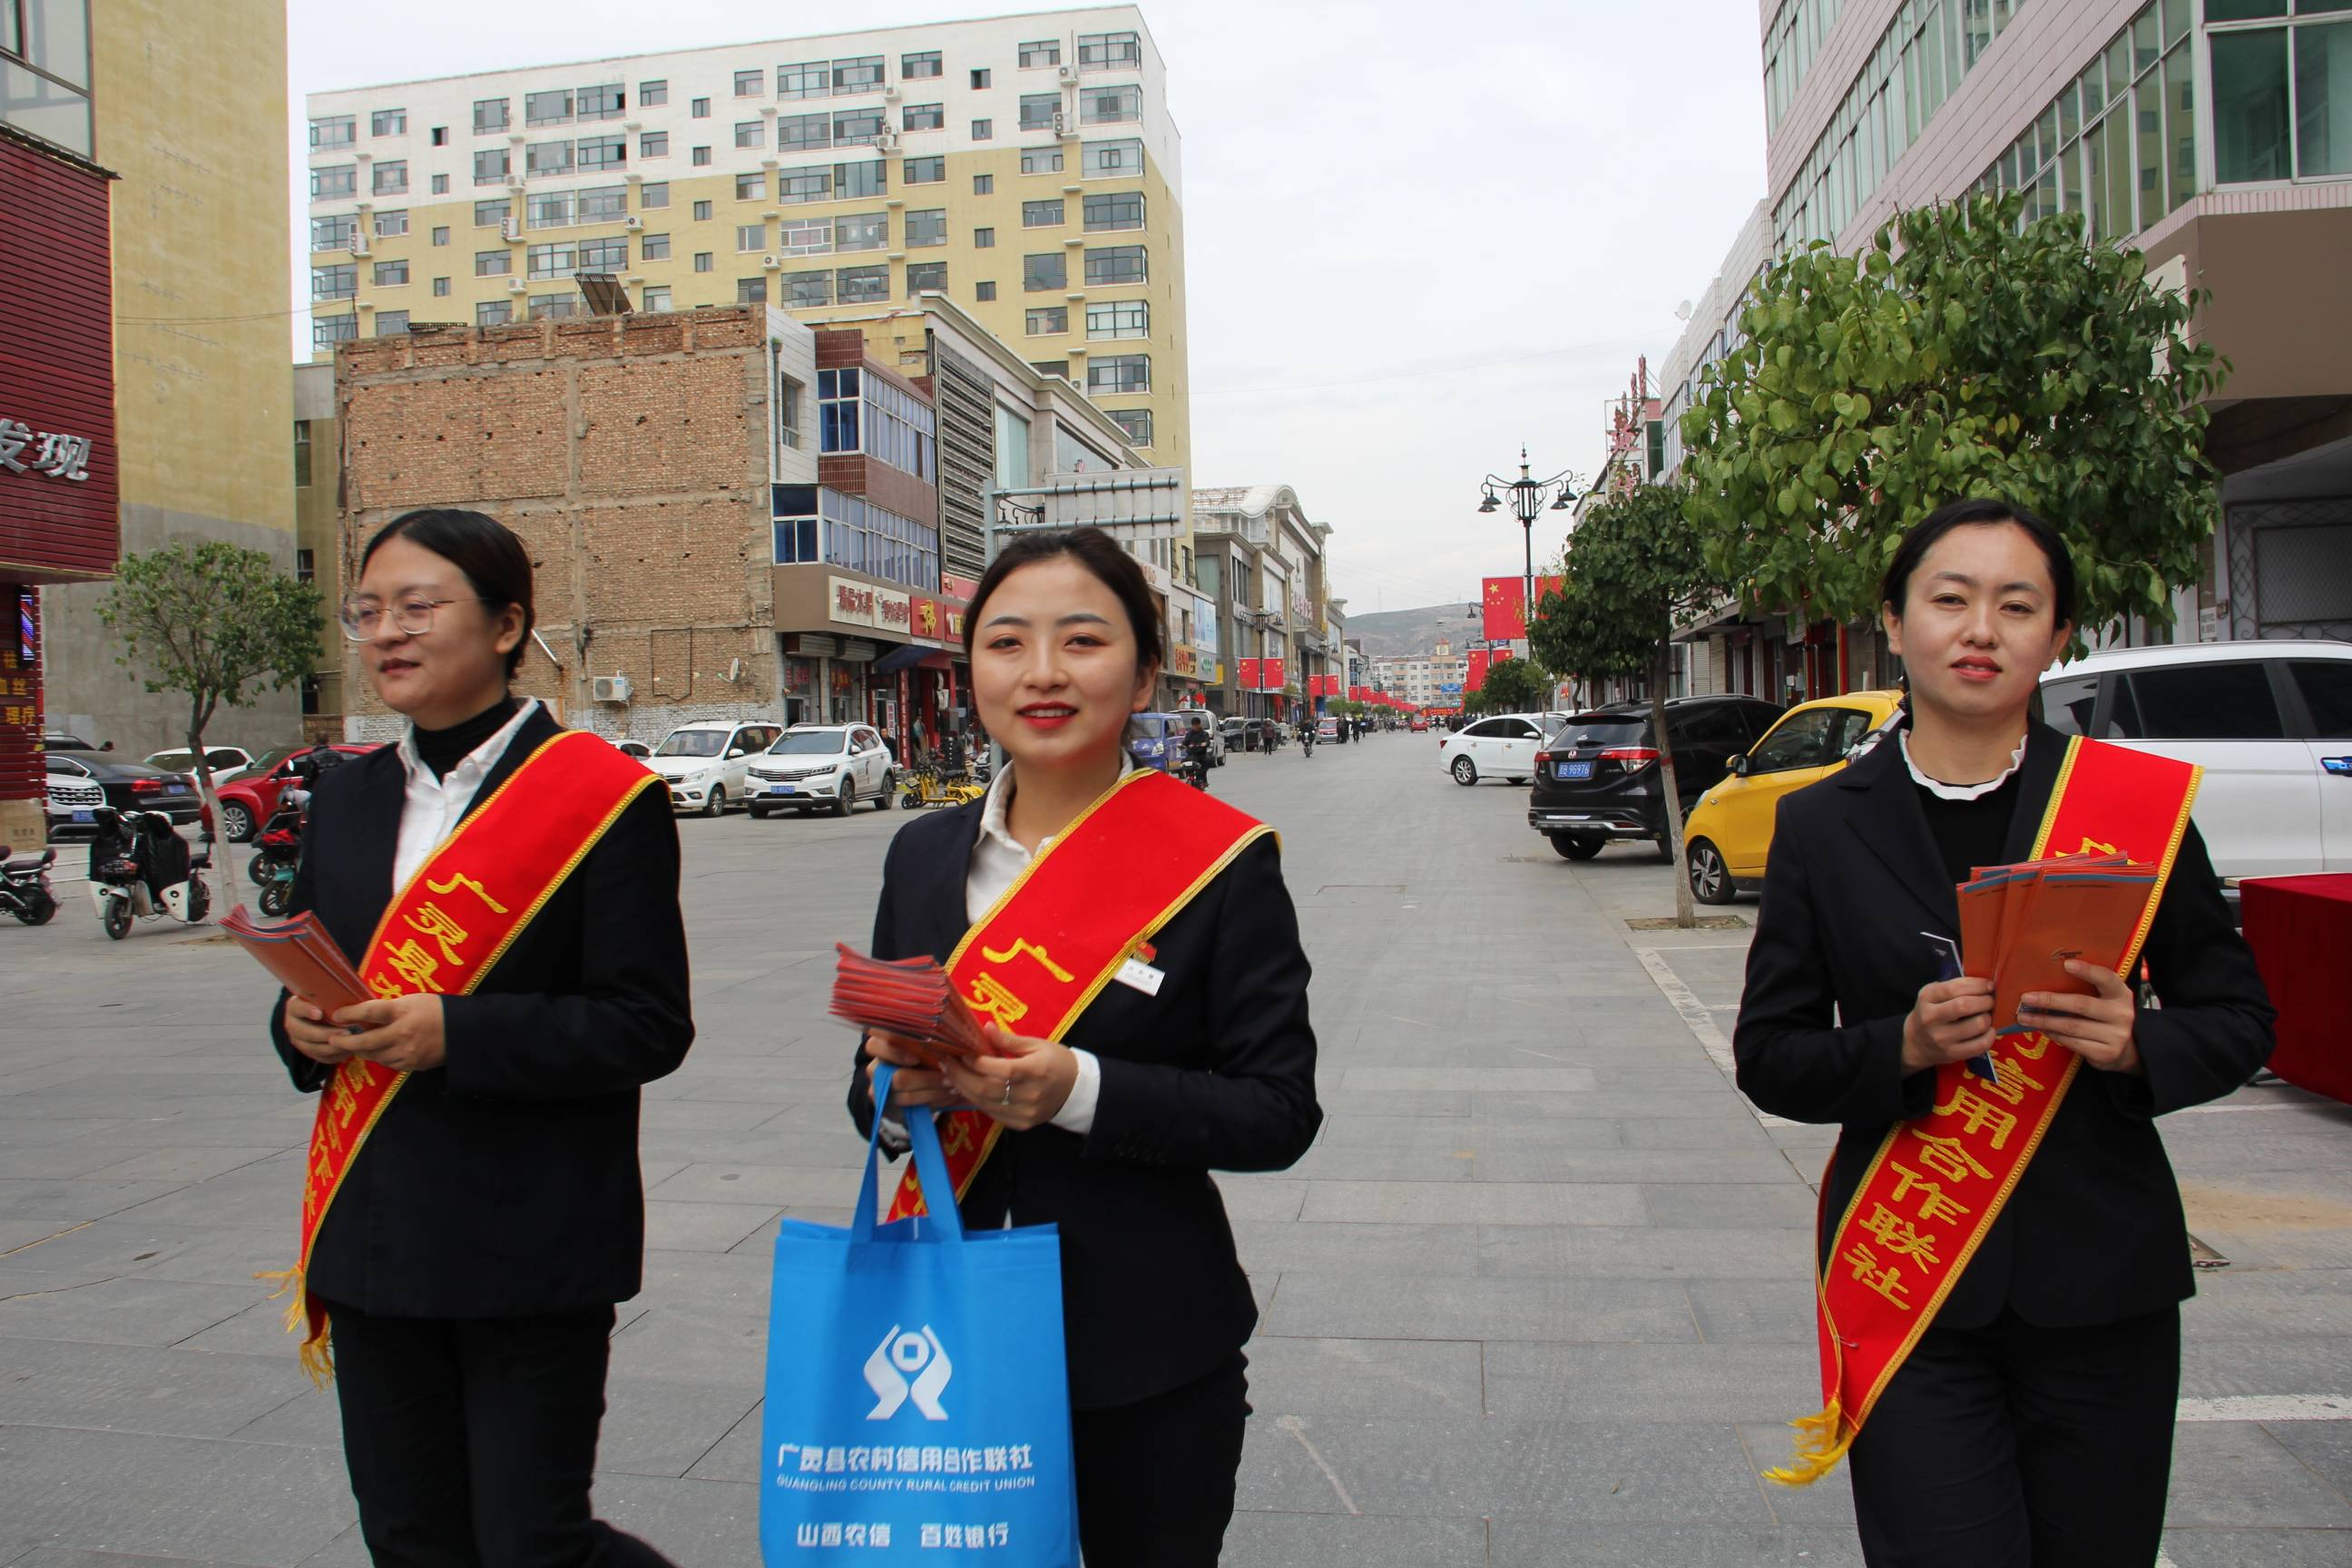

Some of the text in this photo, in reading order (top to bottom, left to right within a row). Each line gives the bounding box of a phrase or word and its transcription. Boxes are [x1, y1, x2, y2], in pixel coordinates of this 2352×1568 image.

[777, 1474, 1035, 1494] GUANGLING COUNTY RURAL CREDIT UNION
[797, 1522, 1009, 1548] 山西农信 百姓银行
